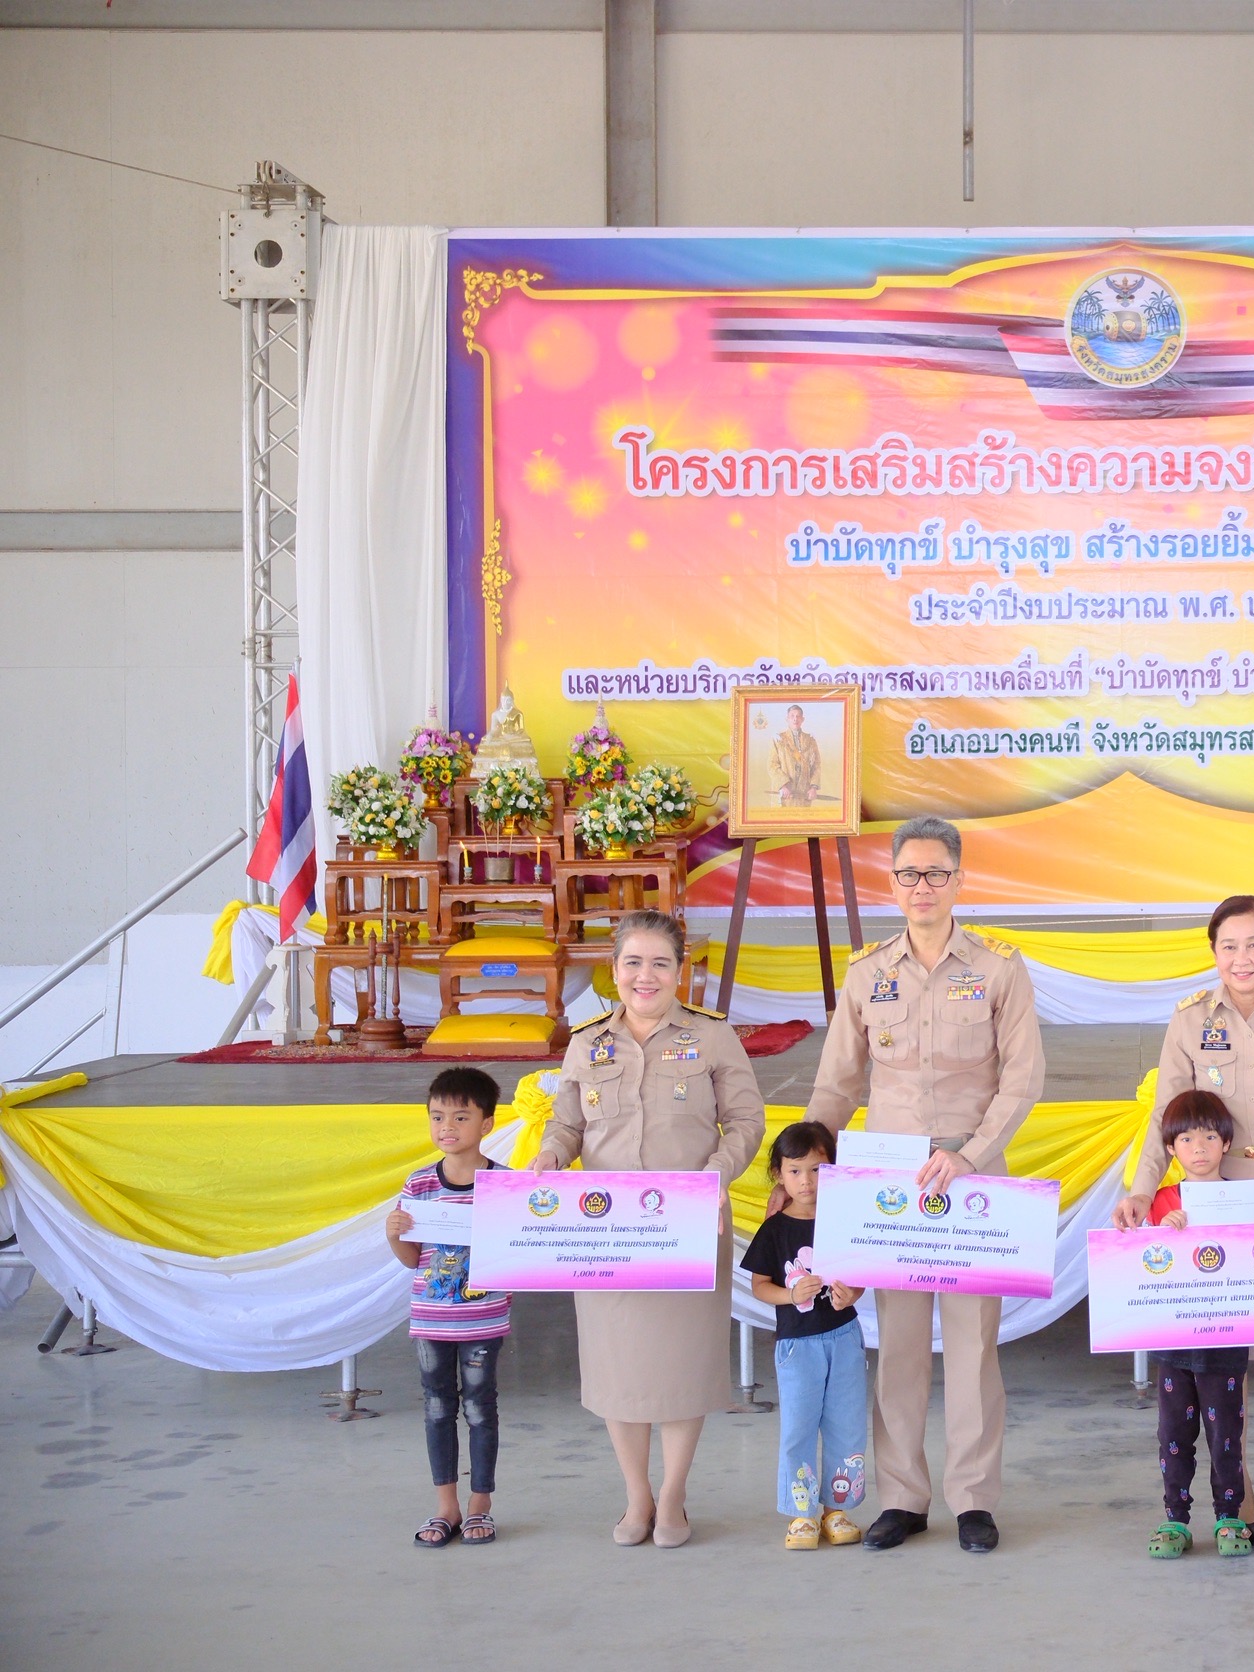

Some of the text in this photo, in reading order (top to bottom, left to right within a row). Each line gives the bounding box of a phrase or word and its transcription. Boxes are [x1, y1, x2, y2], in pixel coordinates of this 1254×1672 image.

[790, 522, 938, 575] บำบัดทุกข์
[952, 523, 1070, 574] บำรุงสุข
[914, 587, 1168, 621] ประจำปีงบประมาณ
[1179, 594, 1235, 619] พ.ศ.
[1095, 656, 1222, 701] “บำบัดทุกข์
[910, 721, 1080, 754] อำเภอบางคนที
[572, 1270, 596, 1278] 1,000
[908, 1274, 936, 1285] 1,000
